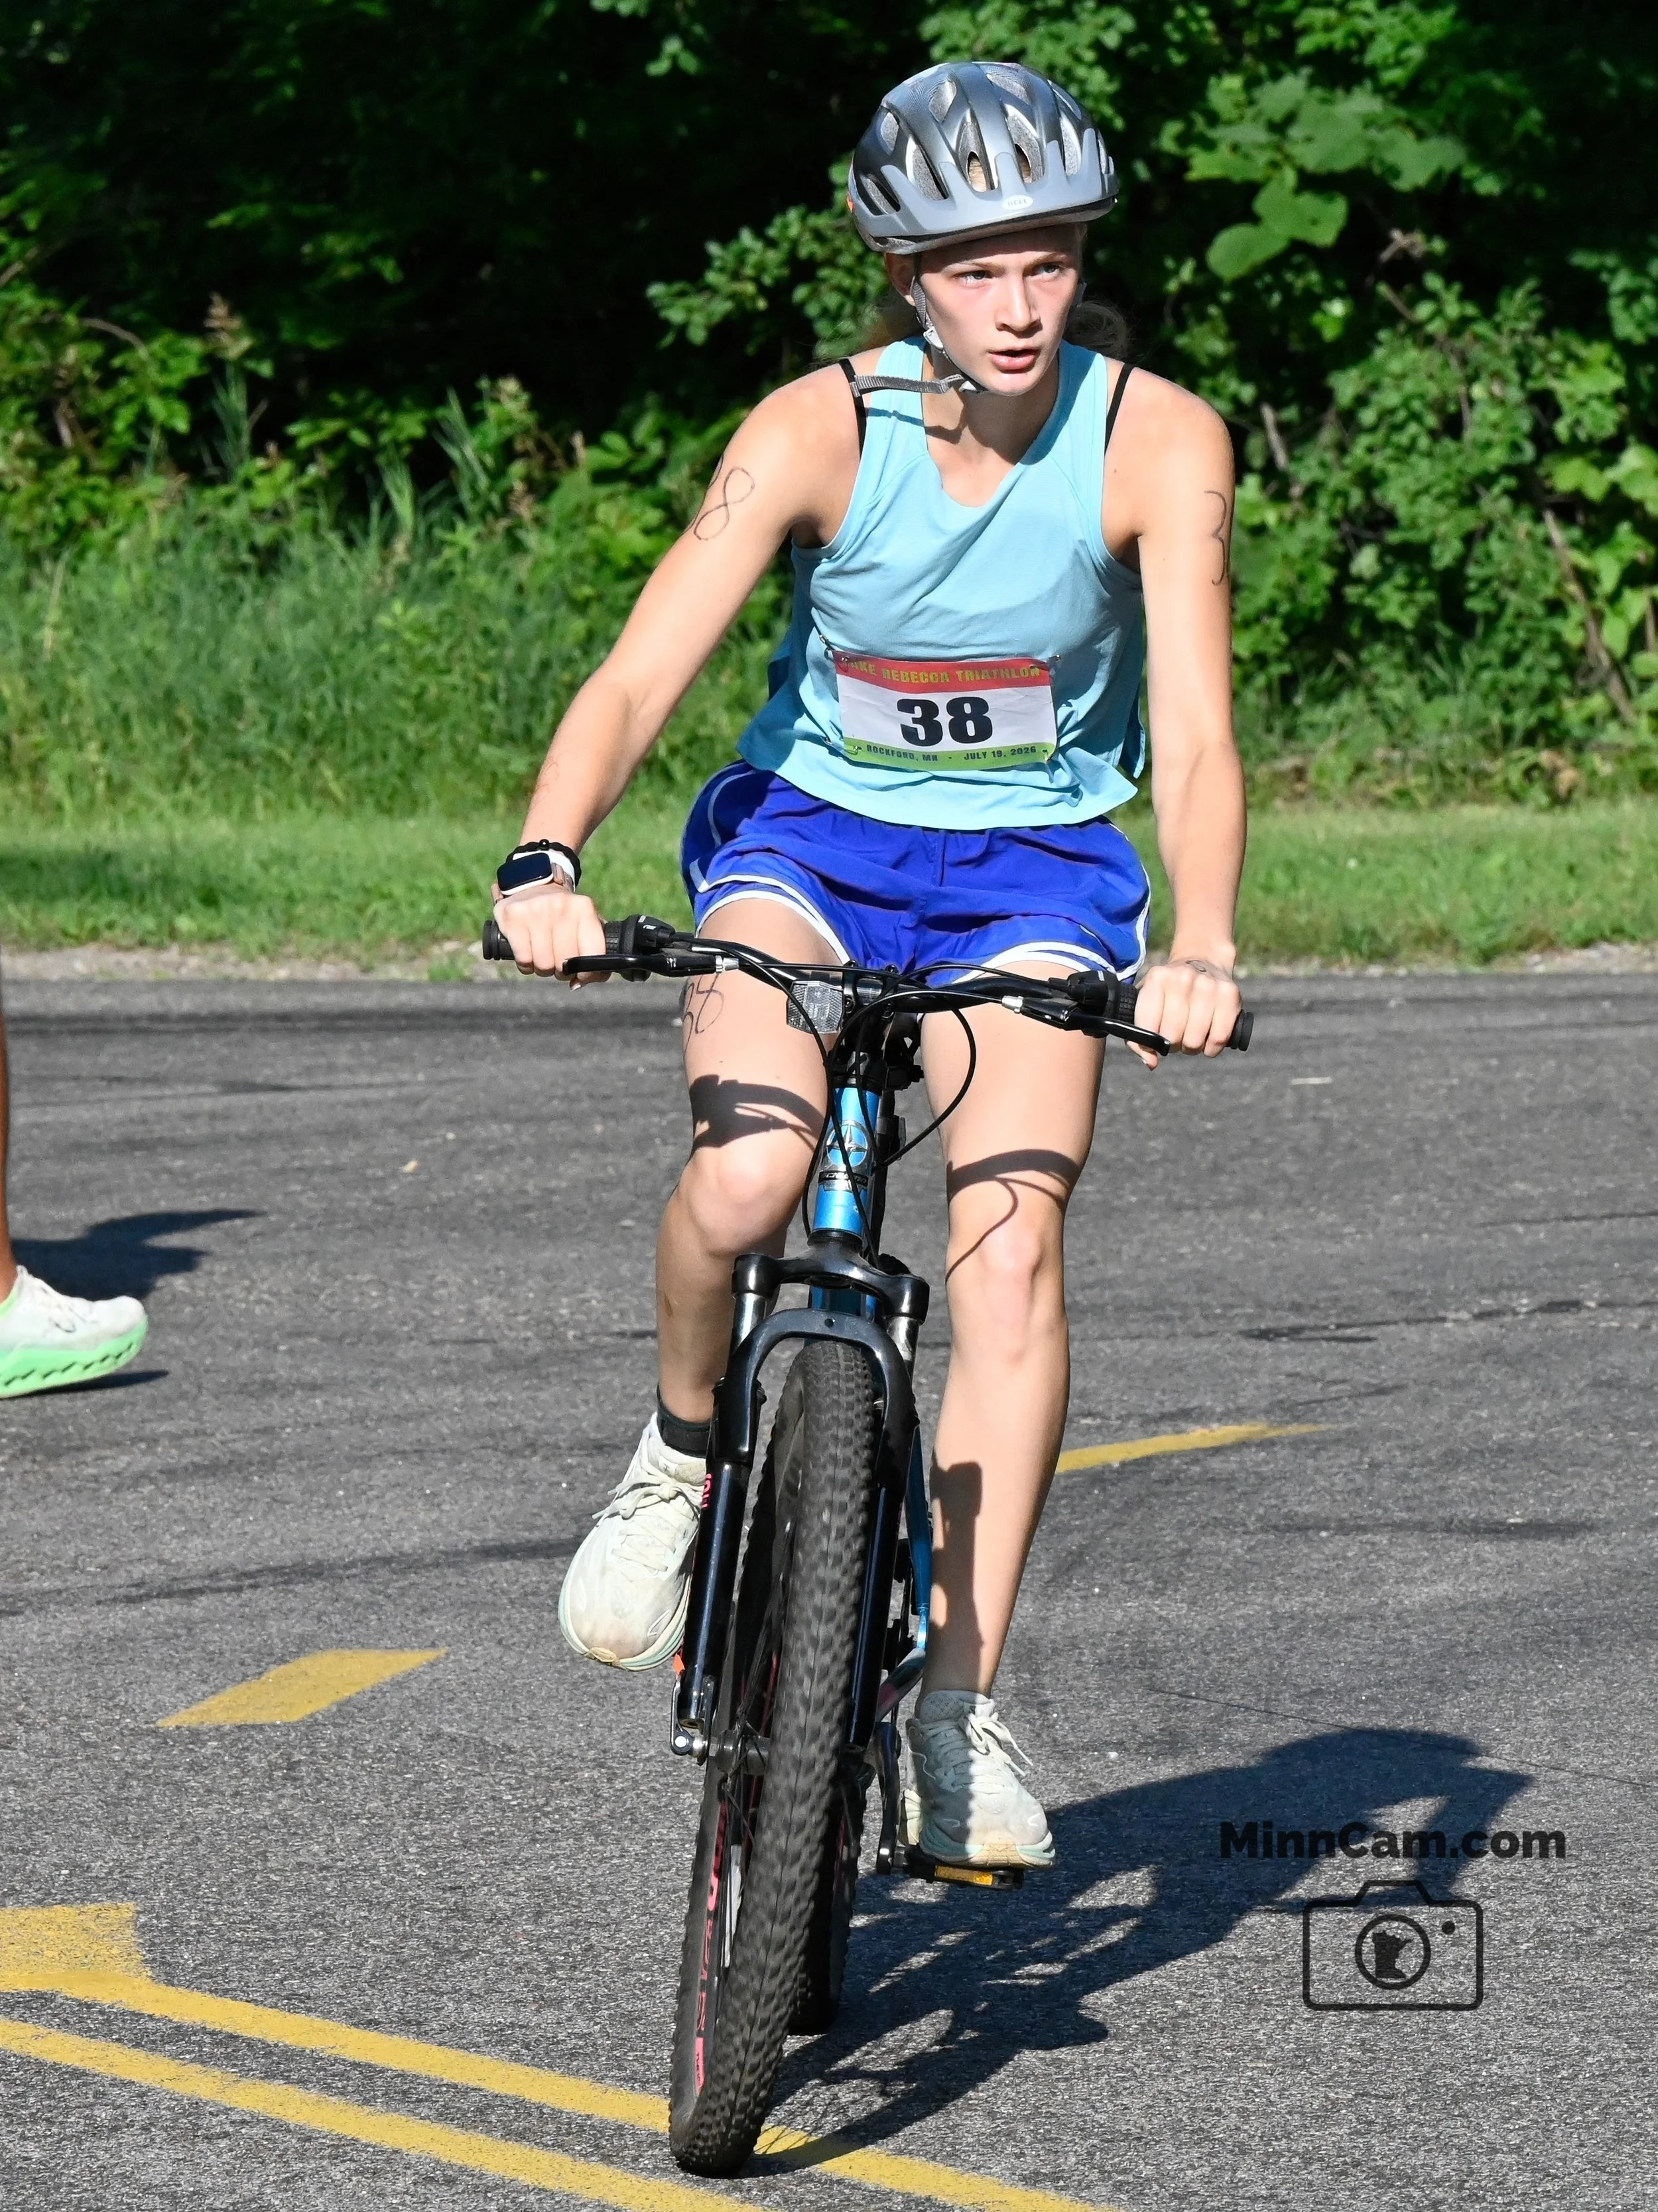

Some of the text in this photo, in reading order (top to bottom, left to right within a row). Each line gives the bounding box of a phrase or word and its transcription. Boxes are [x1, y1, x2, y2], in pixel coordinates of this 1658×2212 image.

[849, 660, 1041, 683] AKE REBECCA TRIATHLON
[897, 696, 993, 747] 38
[866, 744, 919, 761] ROCKFORD,
[964, 751, 988, 761] JULY
[1010, 746, 1037, 755] 2026
